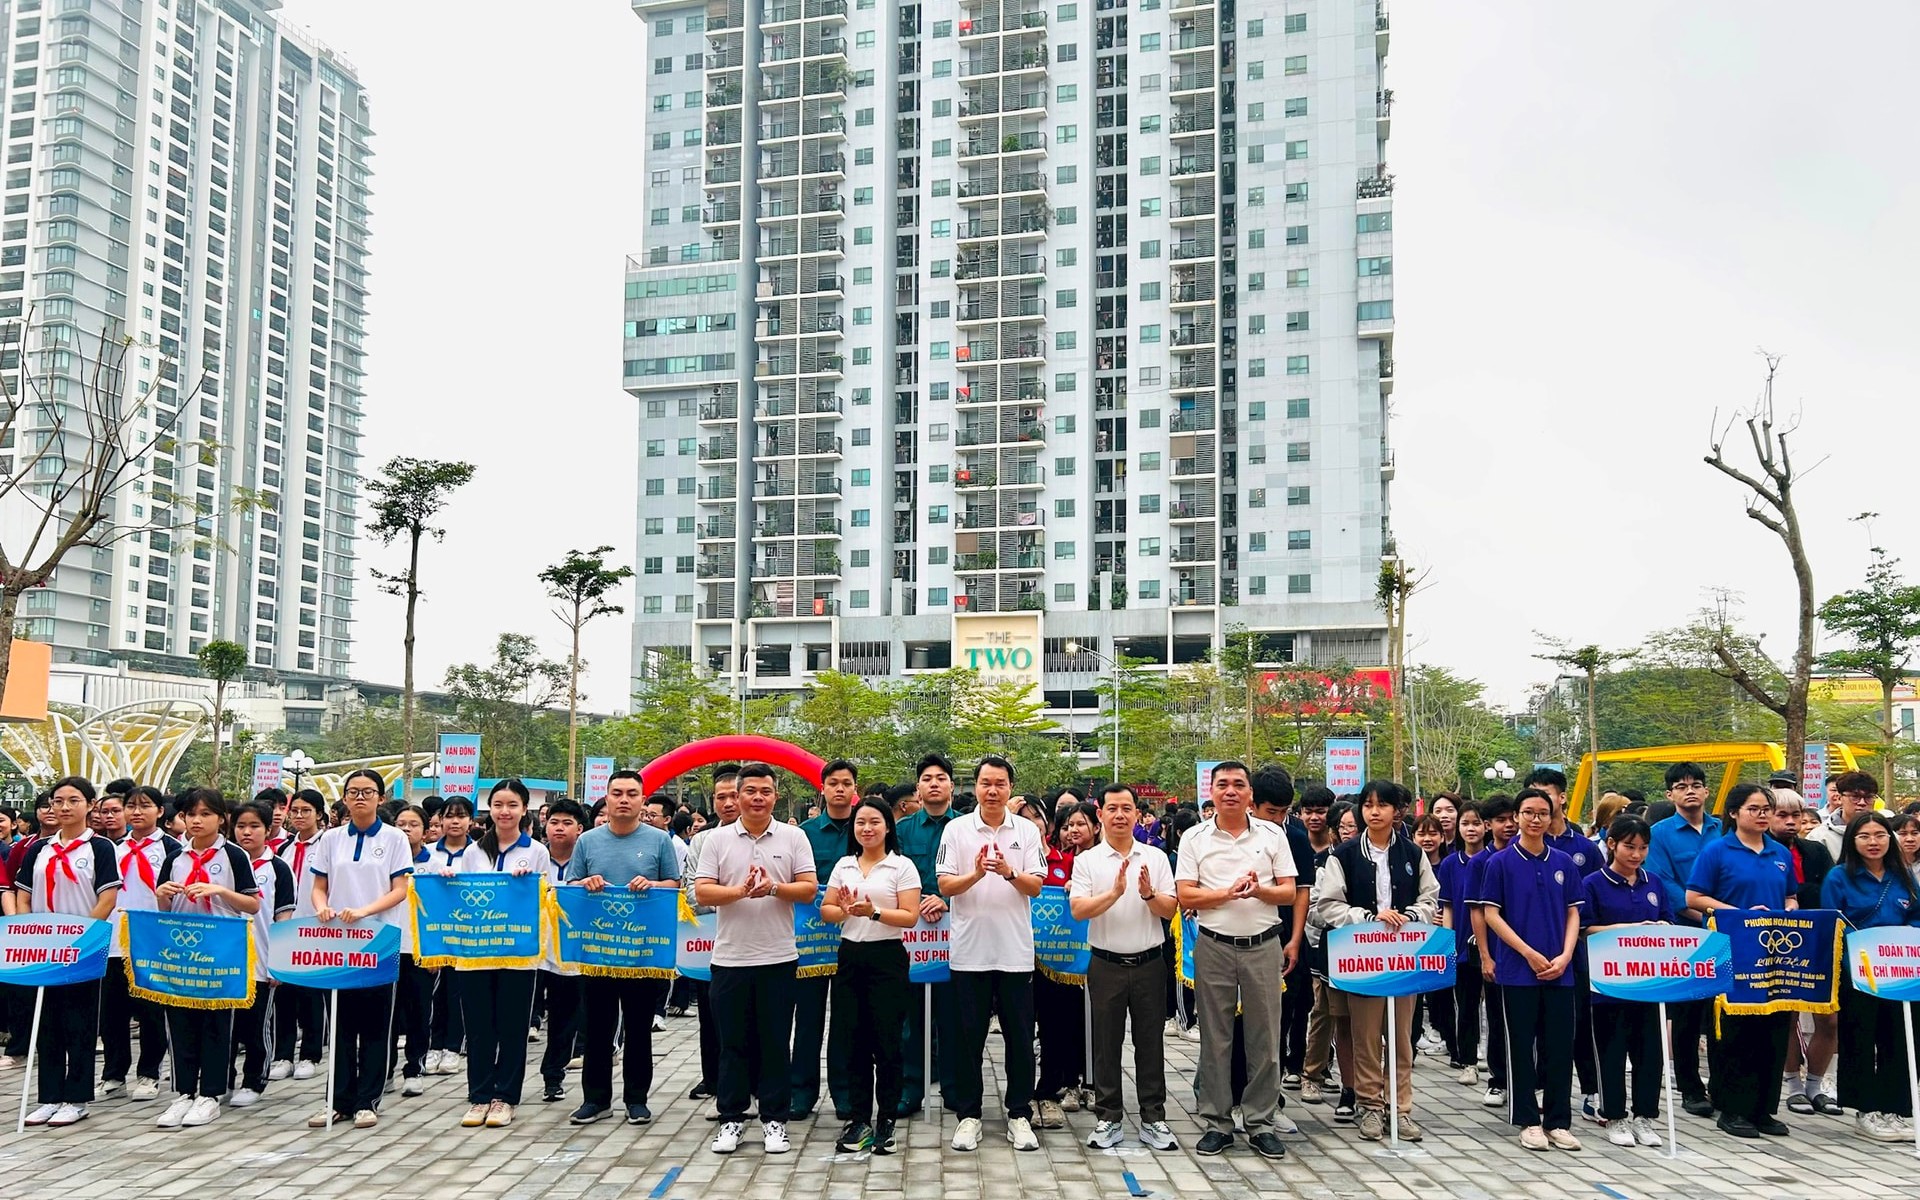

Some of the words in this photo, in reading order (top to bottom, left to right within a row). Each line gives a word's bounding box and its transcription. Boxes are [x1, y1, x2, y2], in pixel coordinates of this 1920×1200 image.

[986, 632, 1011, 643] THE
[965, 647, 1032, 670] TWO
[968, 675, 1032, 686] ESIDENCE
[459, 745, 477, 757] ĐỘNG
[8, 922, 53, 935] TRƯỜNG
[57, 925, 84, 935] THCS
[1773, 917, 1798, 928] HOÀNG
[1799, 919, 1813, 929] MAI
[298, 925, 343, 938] TRƯỜNG
[346, 928, 374, 939] THCS
[903, 931, 916, 942] AN
[921, 927, 938, 942] CHỈ
[1353, 930, 1396, 943] TRƯỜNG
[1400, 931, 1427, 942] THPT
[1617, 935, 1665, 947] TRƯỜNG
[1669, 937, 1699, 948] THPT
[5, 949, 47, 966] THỊNH
[51, 946, 80, 966] LIỆT
[914, 949, 929, 965] SỰ
[1878, 943, 1903, 957] ĐOÀN
[292, 949, 343, 966] HOÀNG
[348, 952, 377, 967] MAI
[1338, 955, 1384, 973] HOÀNG
[1388, 954, 1415, 971] VĂN
[1419, 955, 1445, 973] THỤ
[1603, 962, 1622, 977] DL
[1626, 962, 1655, 977] MAI
[1660, 957, 1690, 977] HẮC
[1695, 957, 1717, 977] ĐẾ
[1891, 966, 1914, 978] MINH
